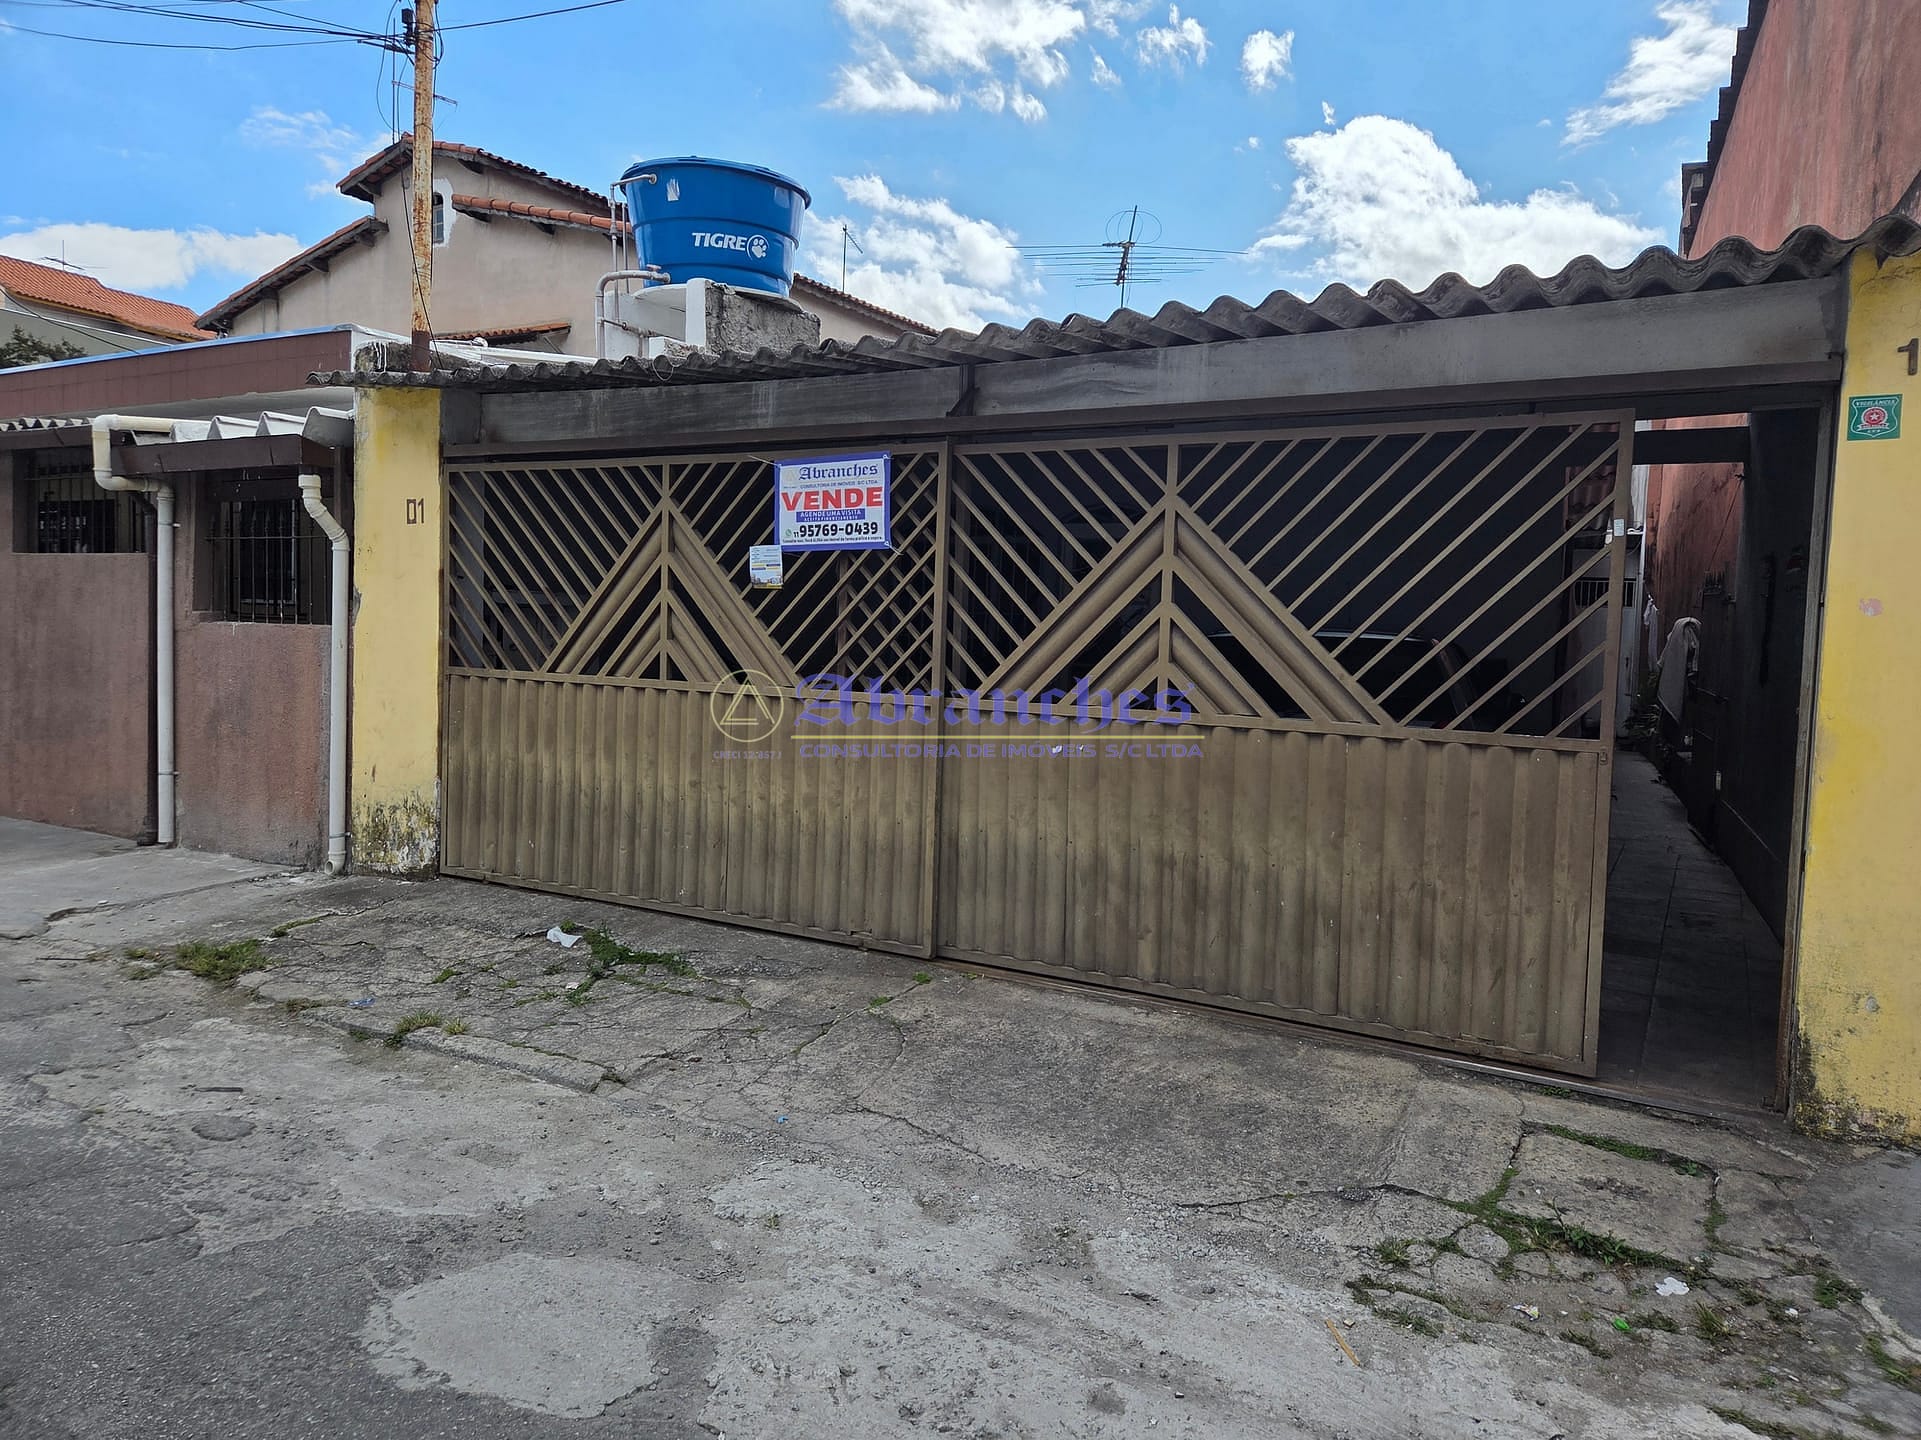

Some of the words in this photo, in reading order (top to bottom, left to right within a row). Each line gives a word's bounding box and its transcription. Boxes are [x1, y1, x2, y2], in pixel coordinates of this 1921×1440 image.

[692, 232, 748, 251] TIGRE
[1897, 338, 1919, 376] 1
[799, 464, 878, 480] Abranches
[781, 487, 883, 511] VENDE
[407, 498, 424, 524] 01
[799, 522, 878, 538] 95769-0439
